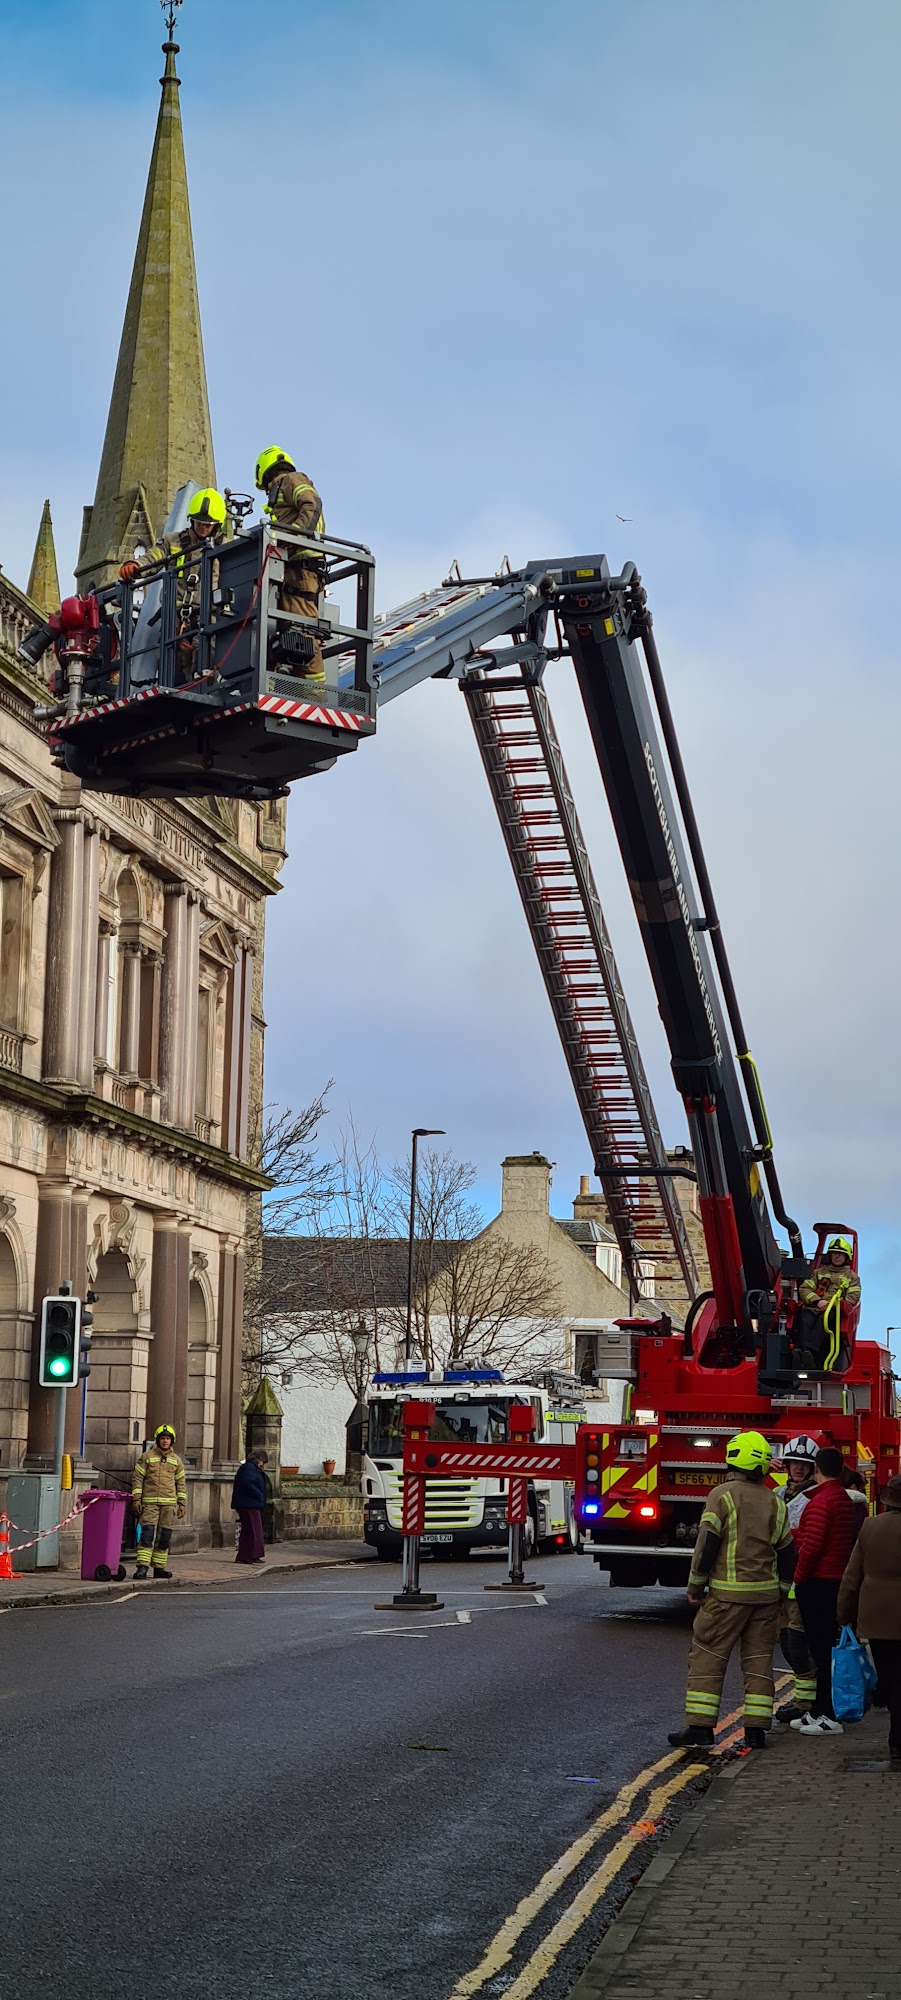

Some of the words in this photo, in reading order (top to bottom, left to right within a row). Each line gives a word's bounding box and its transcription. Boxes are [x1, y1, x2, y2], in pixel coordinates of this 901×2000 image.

[153, 814, 203, 871] INSTITUTE
[644, 741, 670, 841] SCOTTISH
[667, 839, 680, 883] FIRE
[676, 882, 690, 925] AND
[687, 924, 707, 997] RESCUE
[702, 993, 723, 1067] SERVICE
[679, 1474, 705, 1484] SF66
